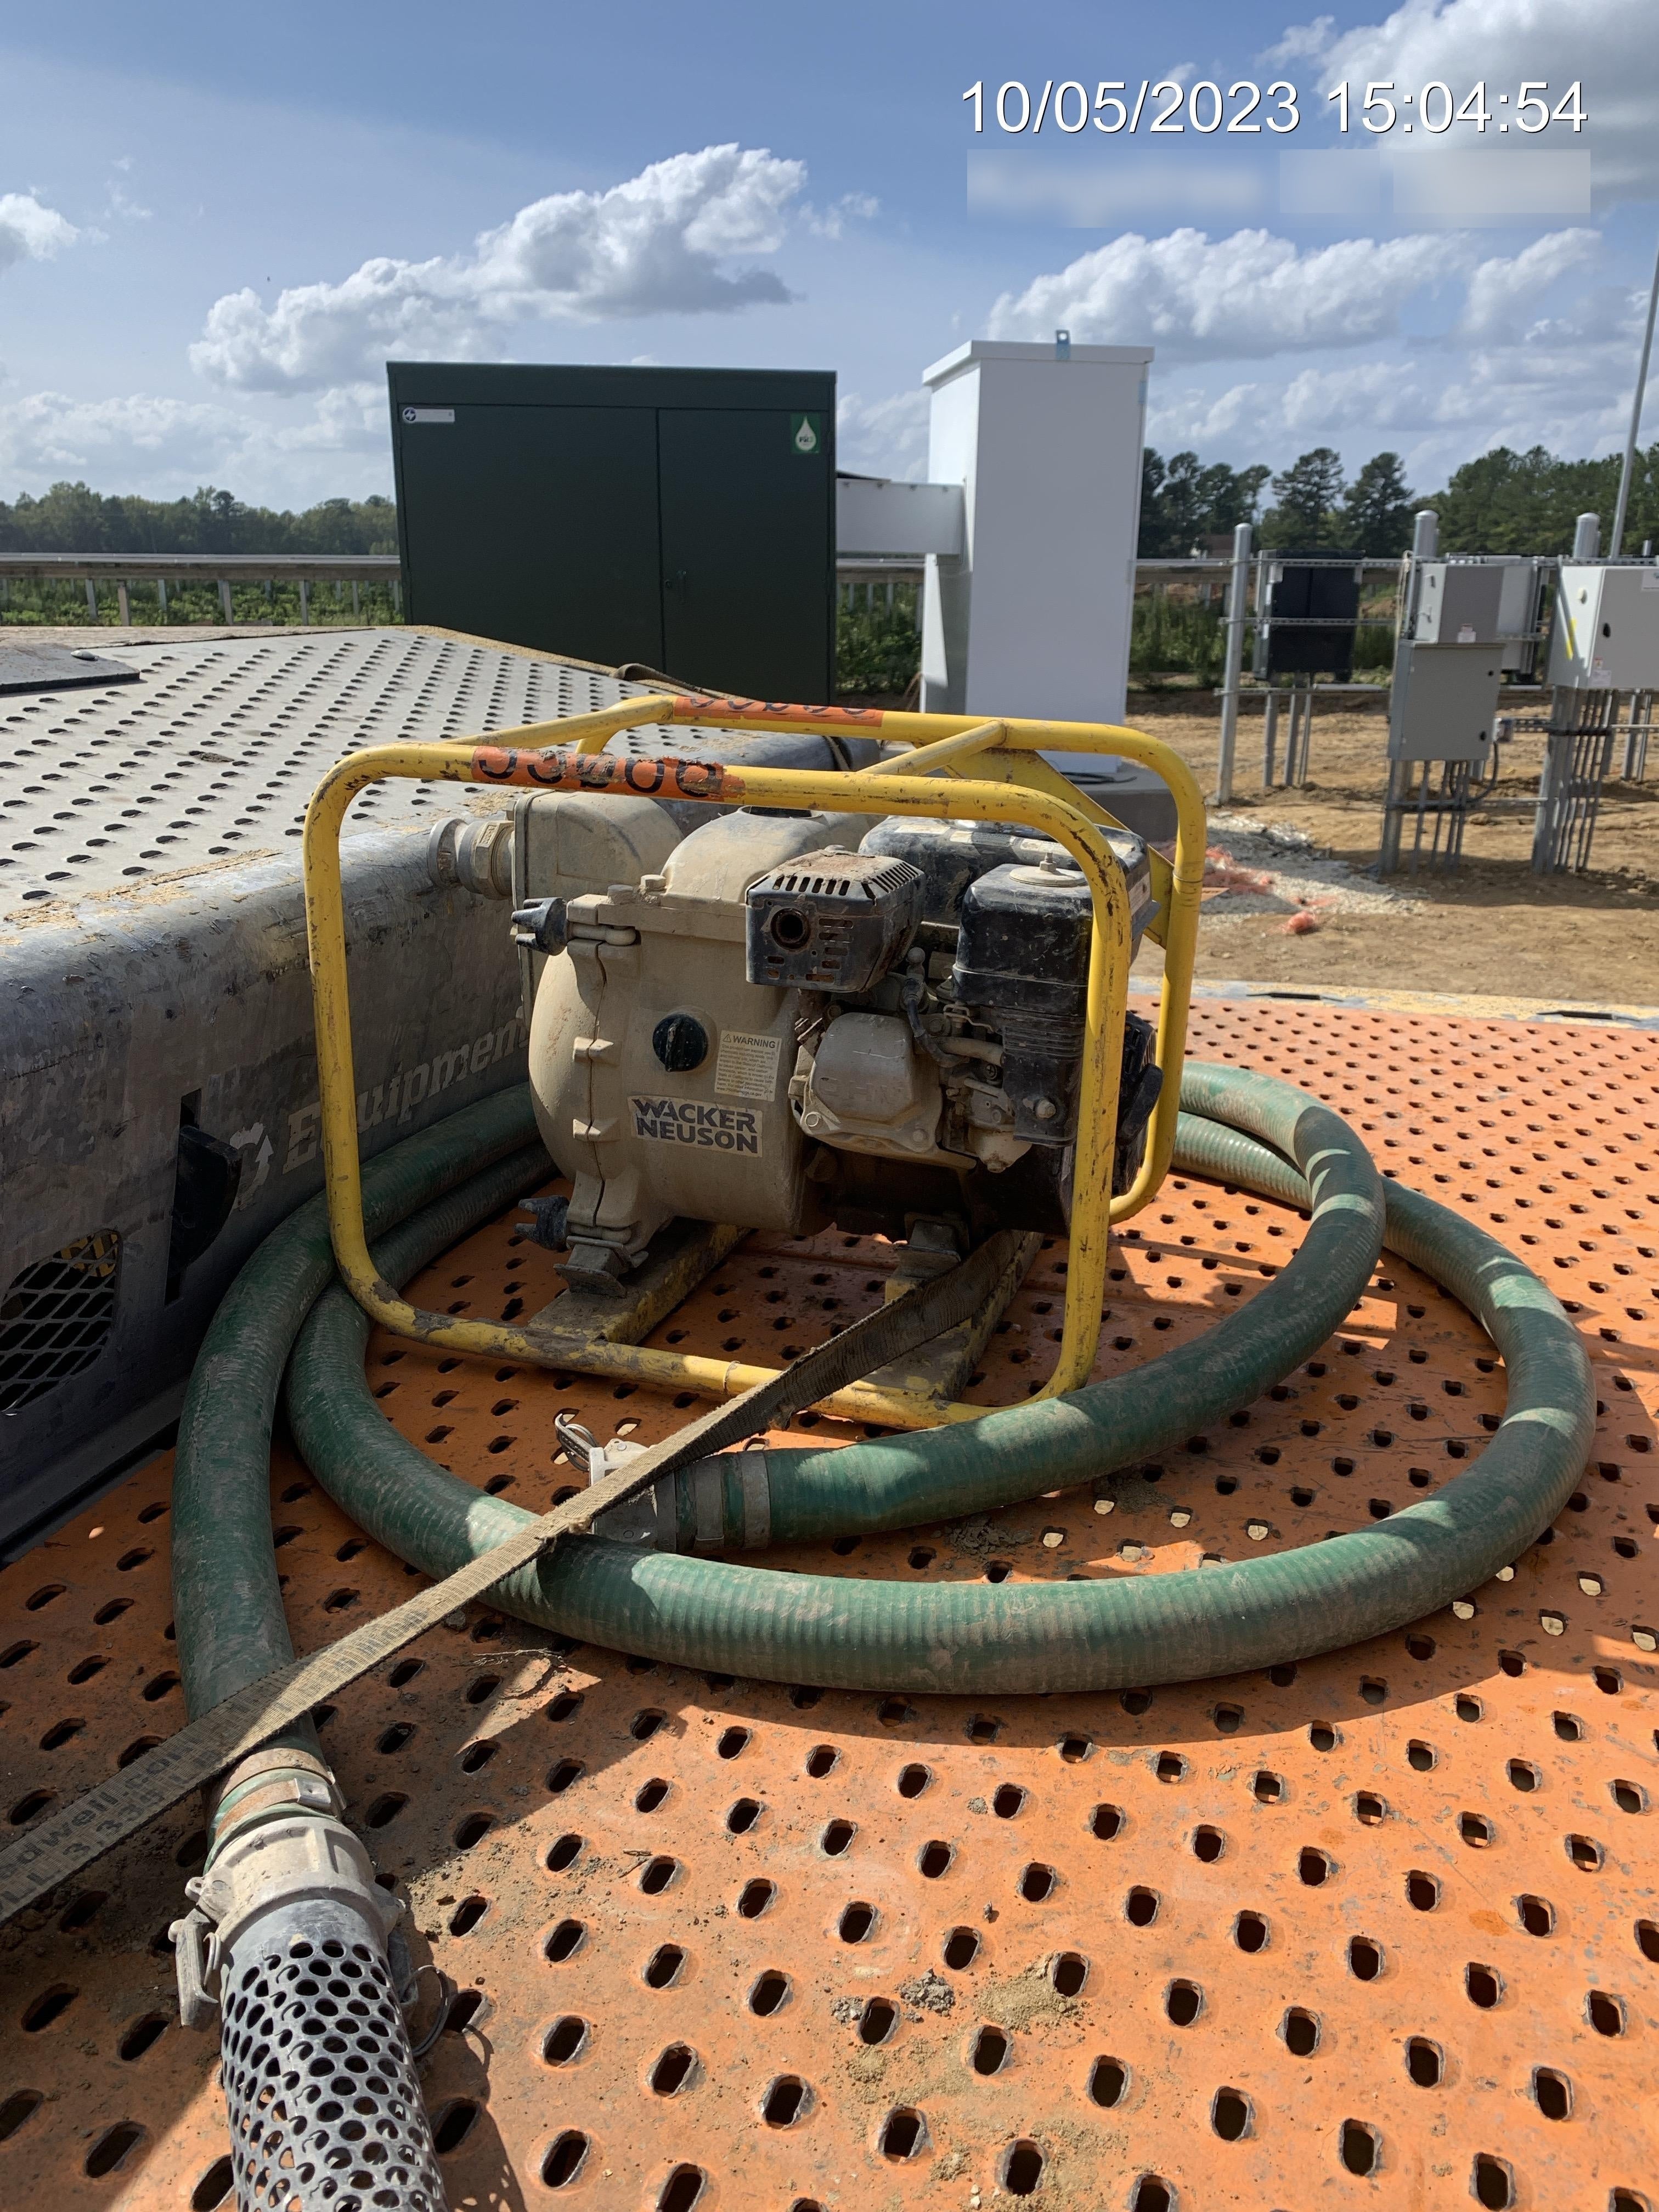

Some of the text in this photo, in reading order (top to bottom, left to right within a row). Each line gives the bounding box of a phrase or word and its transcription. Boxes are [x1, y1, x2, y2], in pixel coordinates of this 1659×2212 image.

[733, 1035, 776, 1048] WARNING
[631, 1098, 758, 1134] WACKER
[636, 1117, 758, 1154] NEUSON
